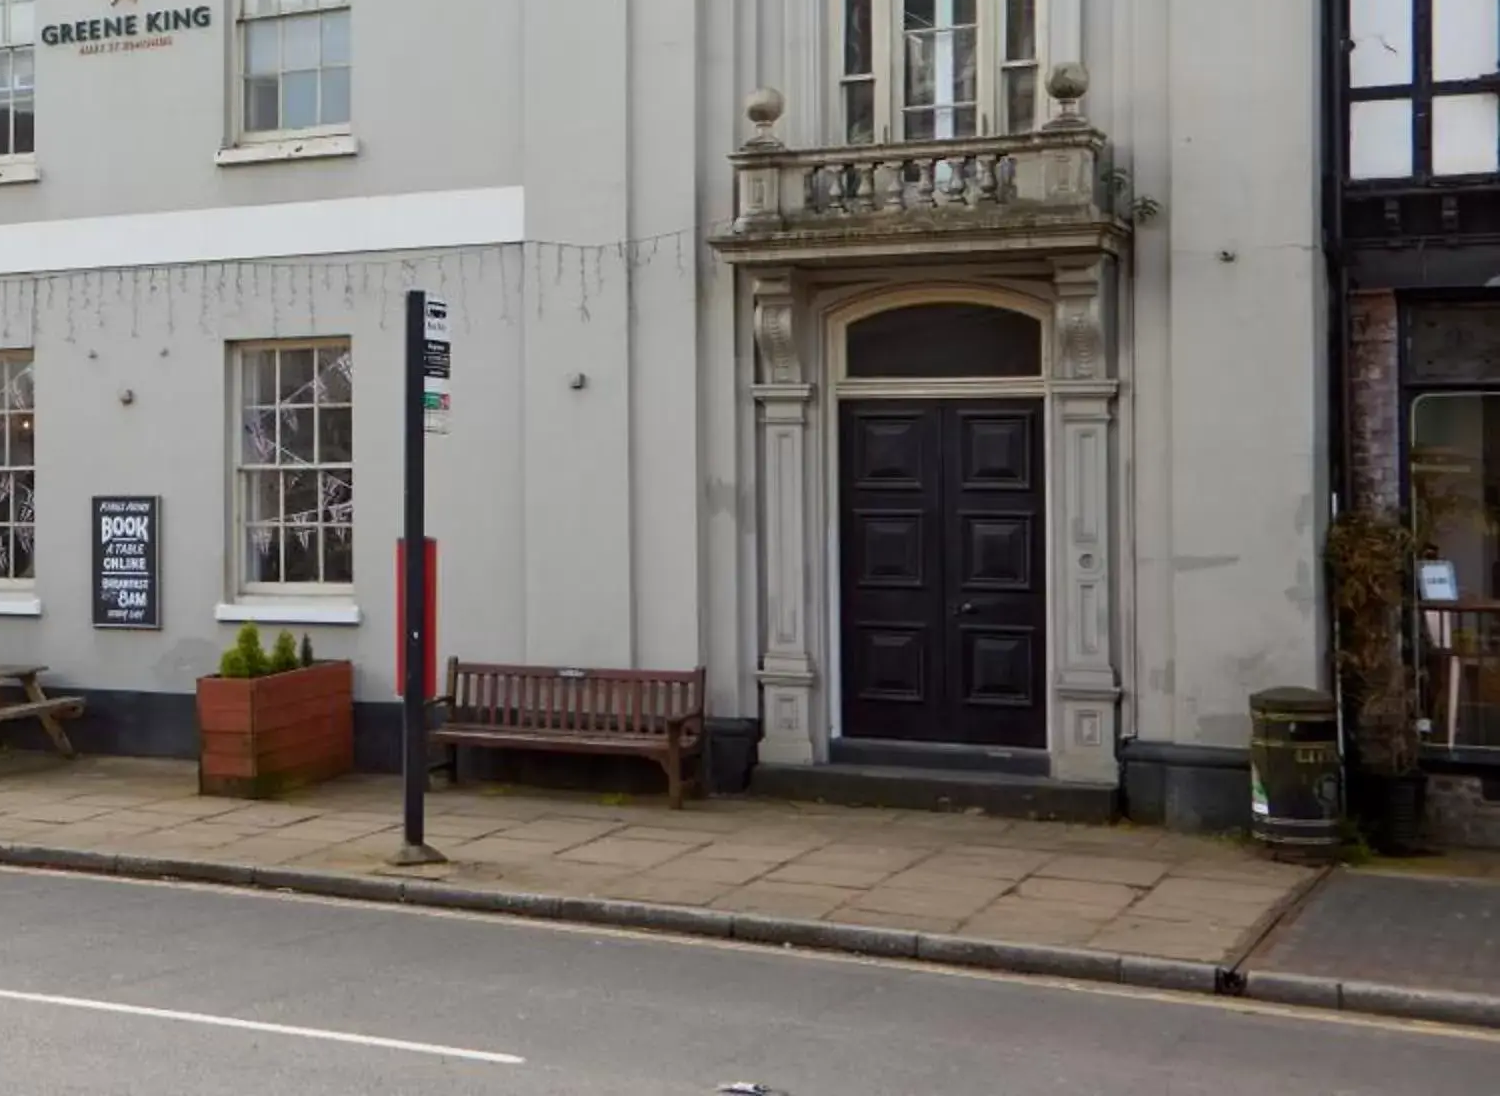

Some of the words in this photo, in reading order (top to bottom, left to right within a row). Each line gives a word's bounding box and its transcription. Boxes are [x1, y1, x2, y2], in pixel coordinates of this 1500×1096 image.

[42, 15, 138, 46] GREENE
[146, 6, 212, 33] KING
[101, 516, 149, 543] BOOK
[106, 544, 114, 554] A
[117, 590, 147, 608] 8AM
